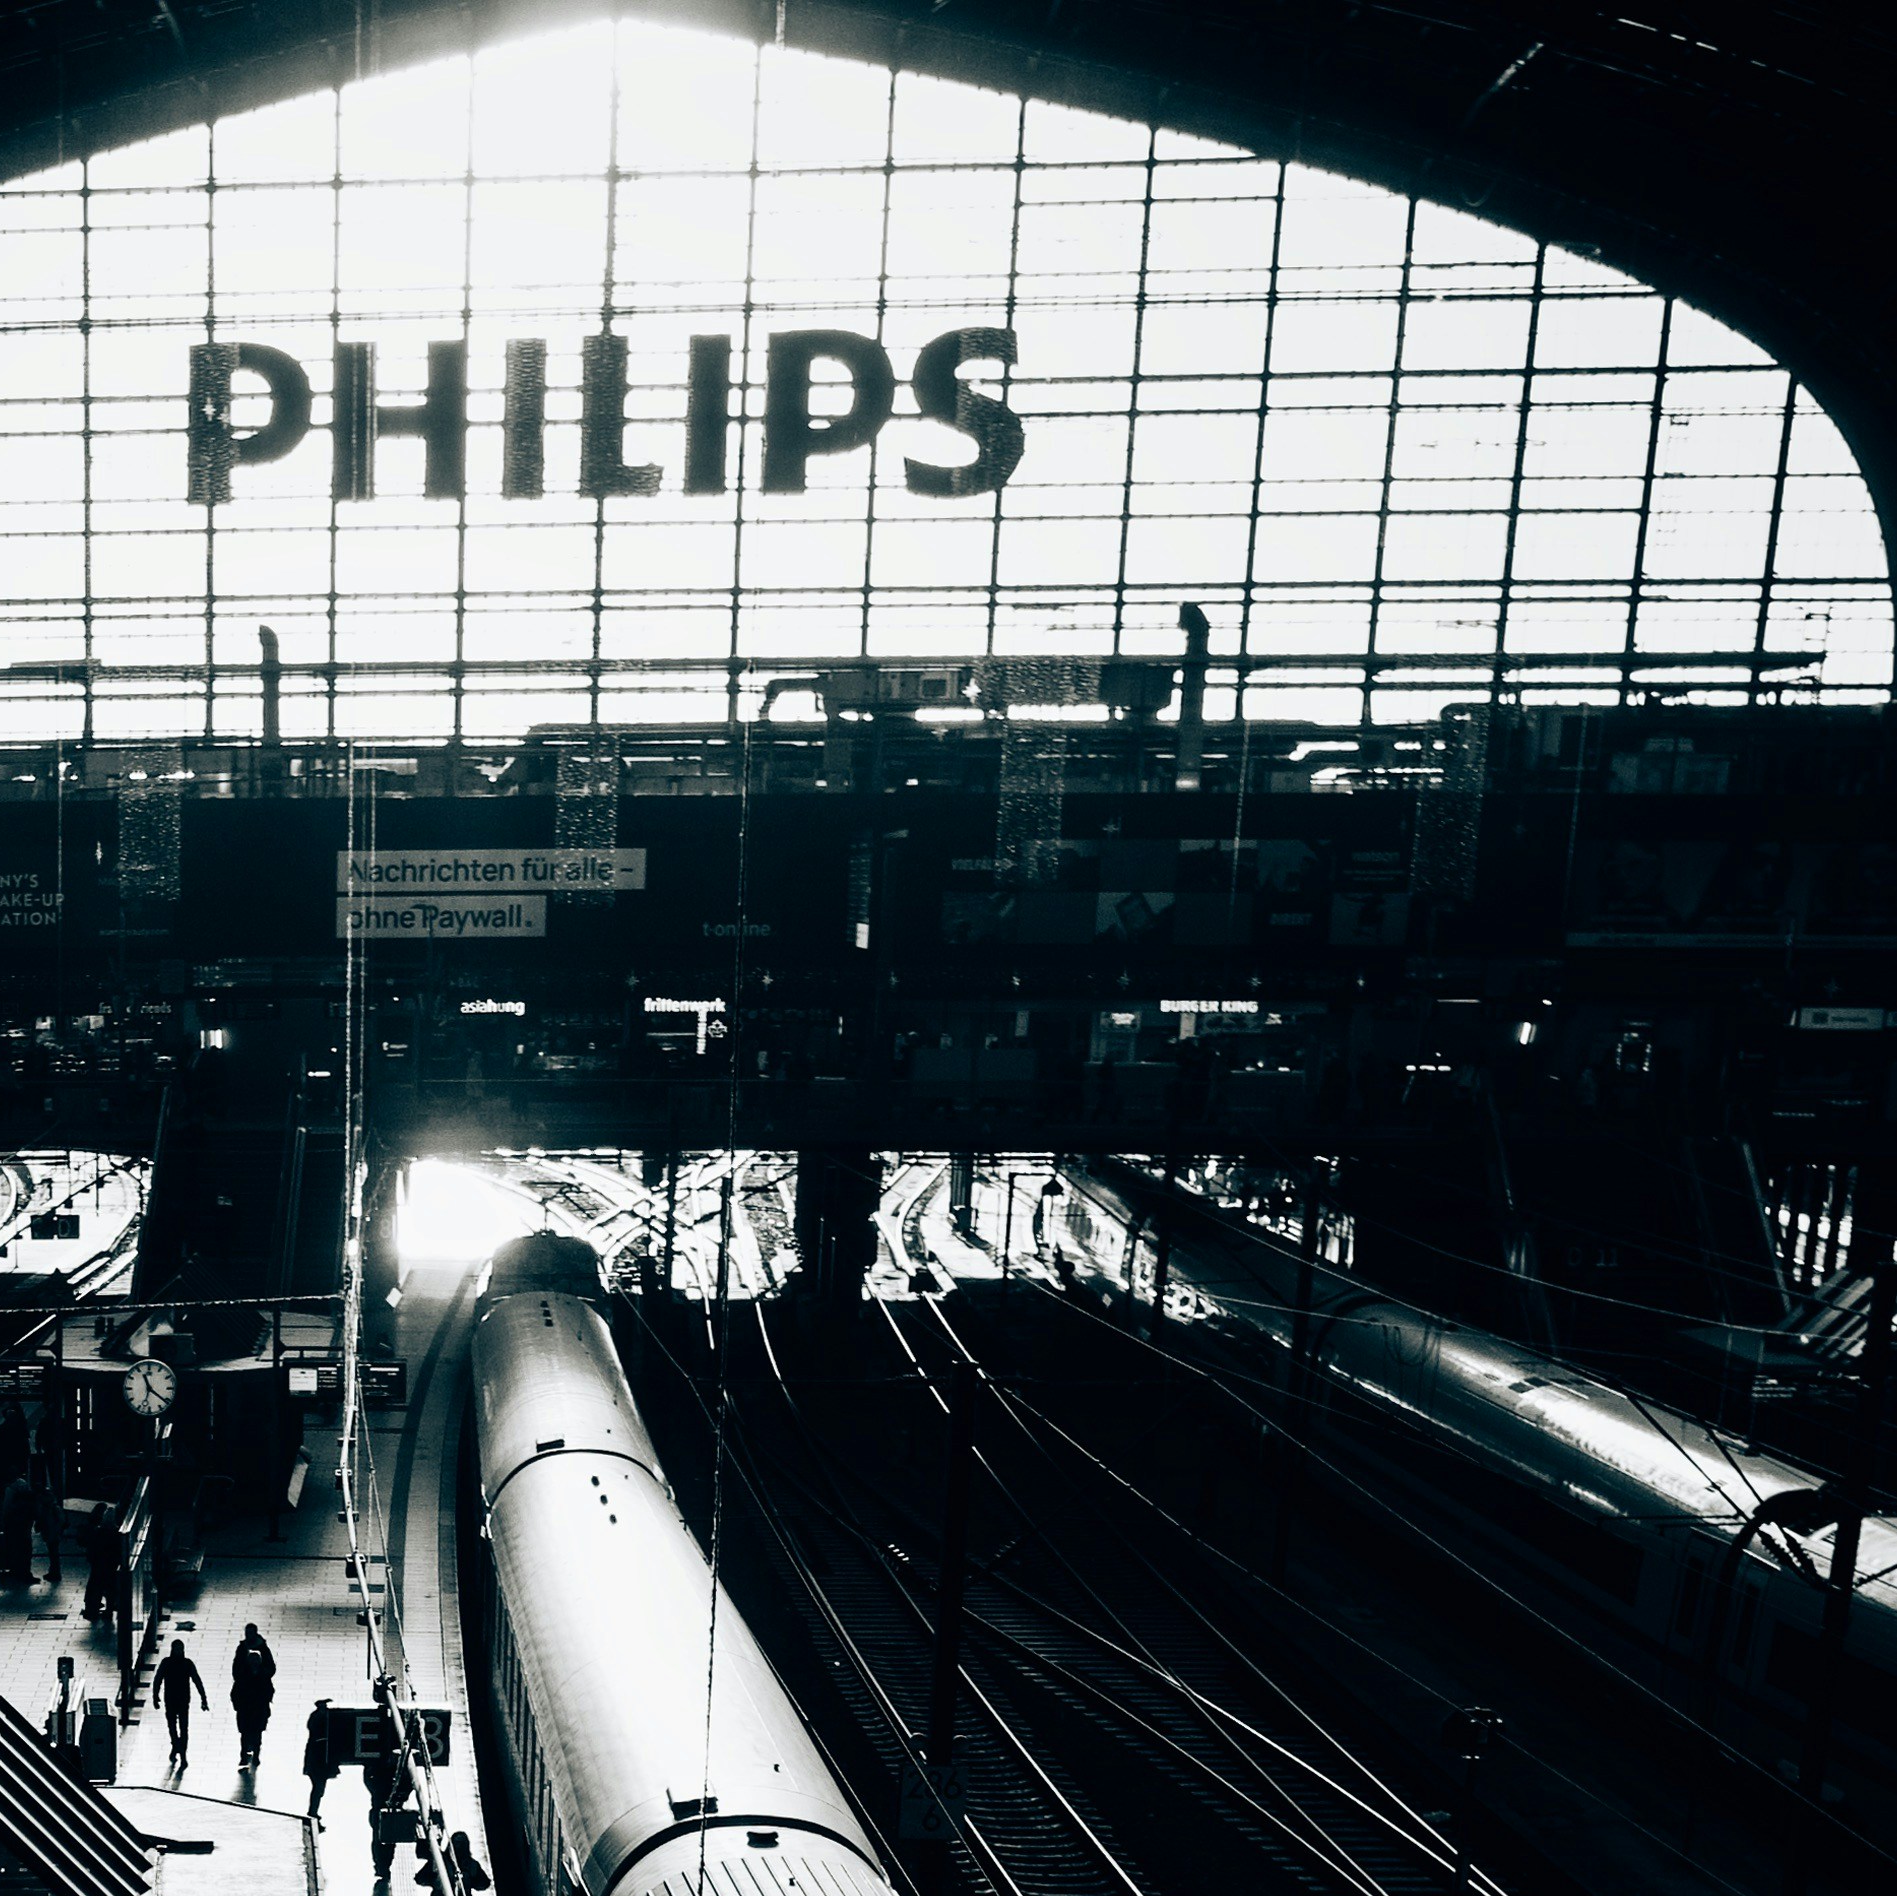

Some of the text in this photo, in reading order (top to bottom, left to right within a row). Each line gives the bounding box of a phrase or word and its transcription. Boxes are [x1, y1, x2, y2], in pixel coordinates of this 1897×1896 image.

[187, 327, 1025, 504] PHILIPS
[351, 858, 515, 884] Nachrichten
[520, 856, 556, 882] für
[565, 857, 615, 883] alle
[349, 903, 534, 935] ohne Paywall.
[1160, 1000, 1259, 1013] BURGER KING
[354, 1716, 381, 1759] E
